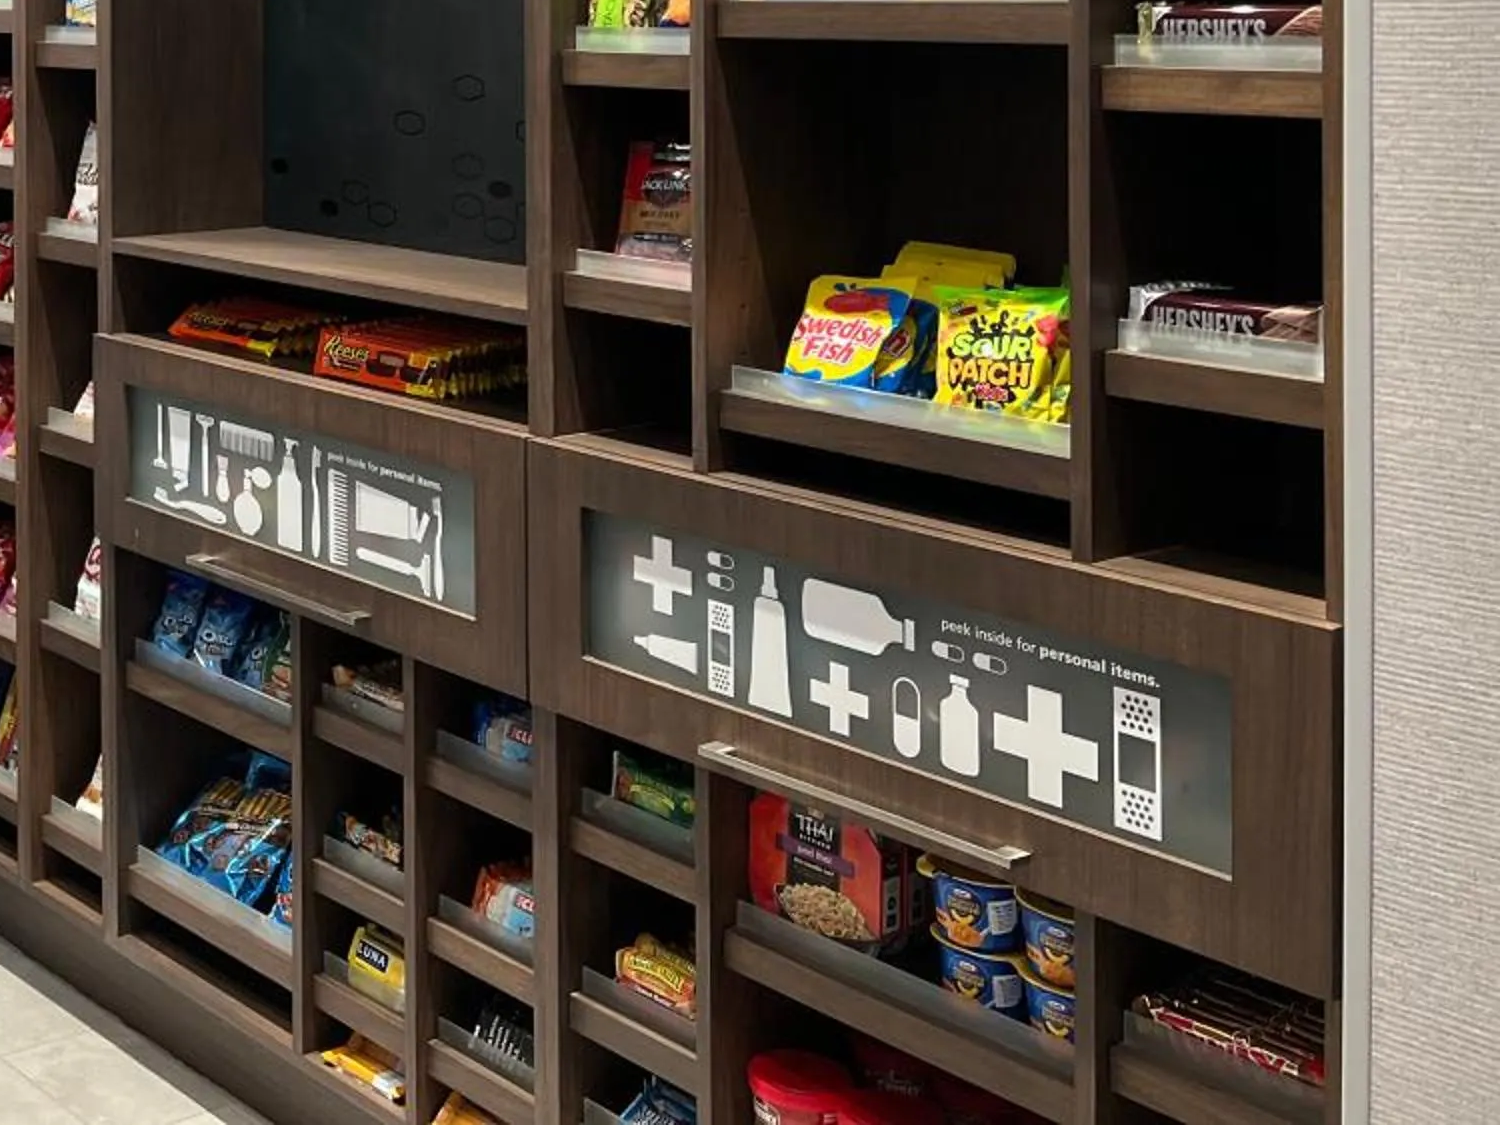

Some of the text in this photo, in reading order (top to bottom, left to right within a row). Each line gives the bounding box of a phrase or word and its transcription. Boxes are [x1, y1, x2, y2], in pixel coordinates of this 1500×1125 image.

[1161, 17, 1267, 46] HERSHEY'S
[796, 312, 887, 348] Swedish
[1151, 305, 1255, 339] HERSHEY'S
[802, 336, 856, 365] Fish
[952, 332, 1033, 362] SOUR
[947, 356, 1035, 390] PATCH
[940, 618, 1161, 689] peek inside for personal items.
[795, 812, 834, 843] THAI
[356, 940, 387, 969] LUNA
